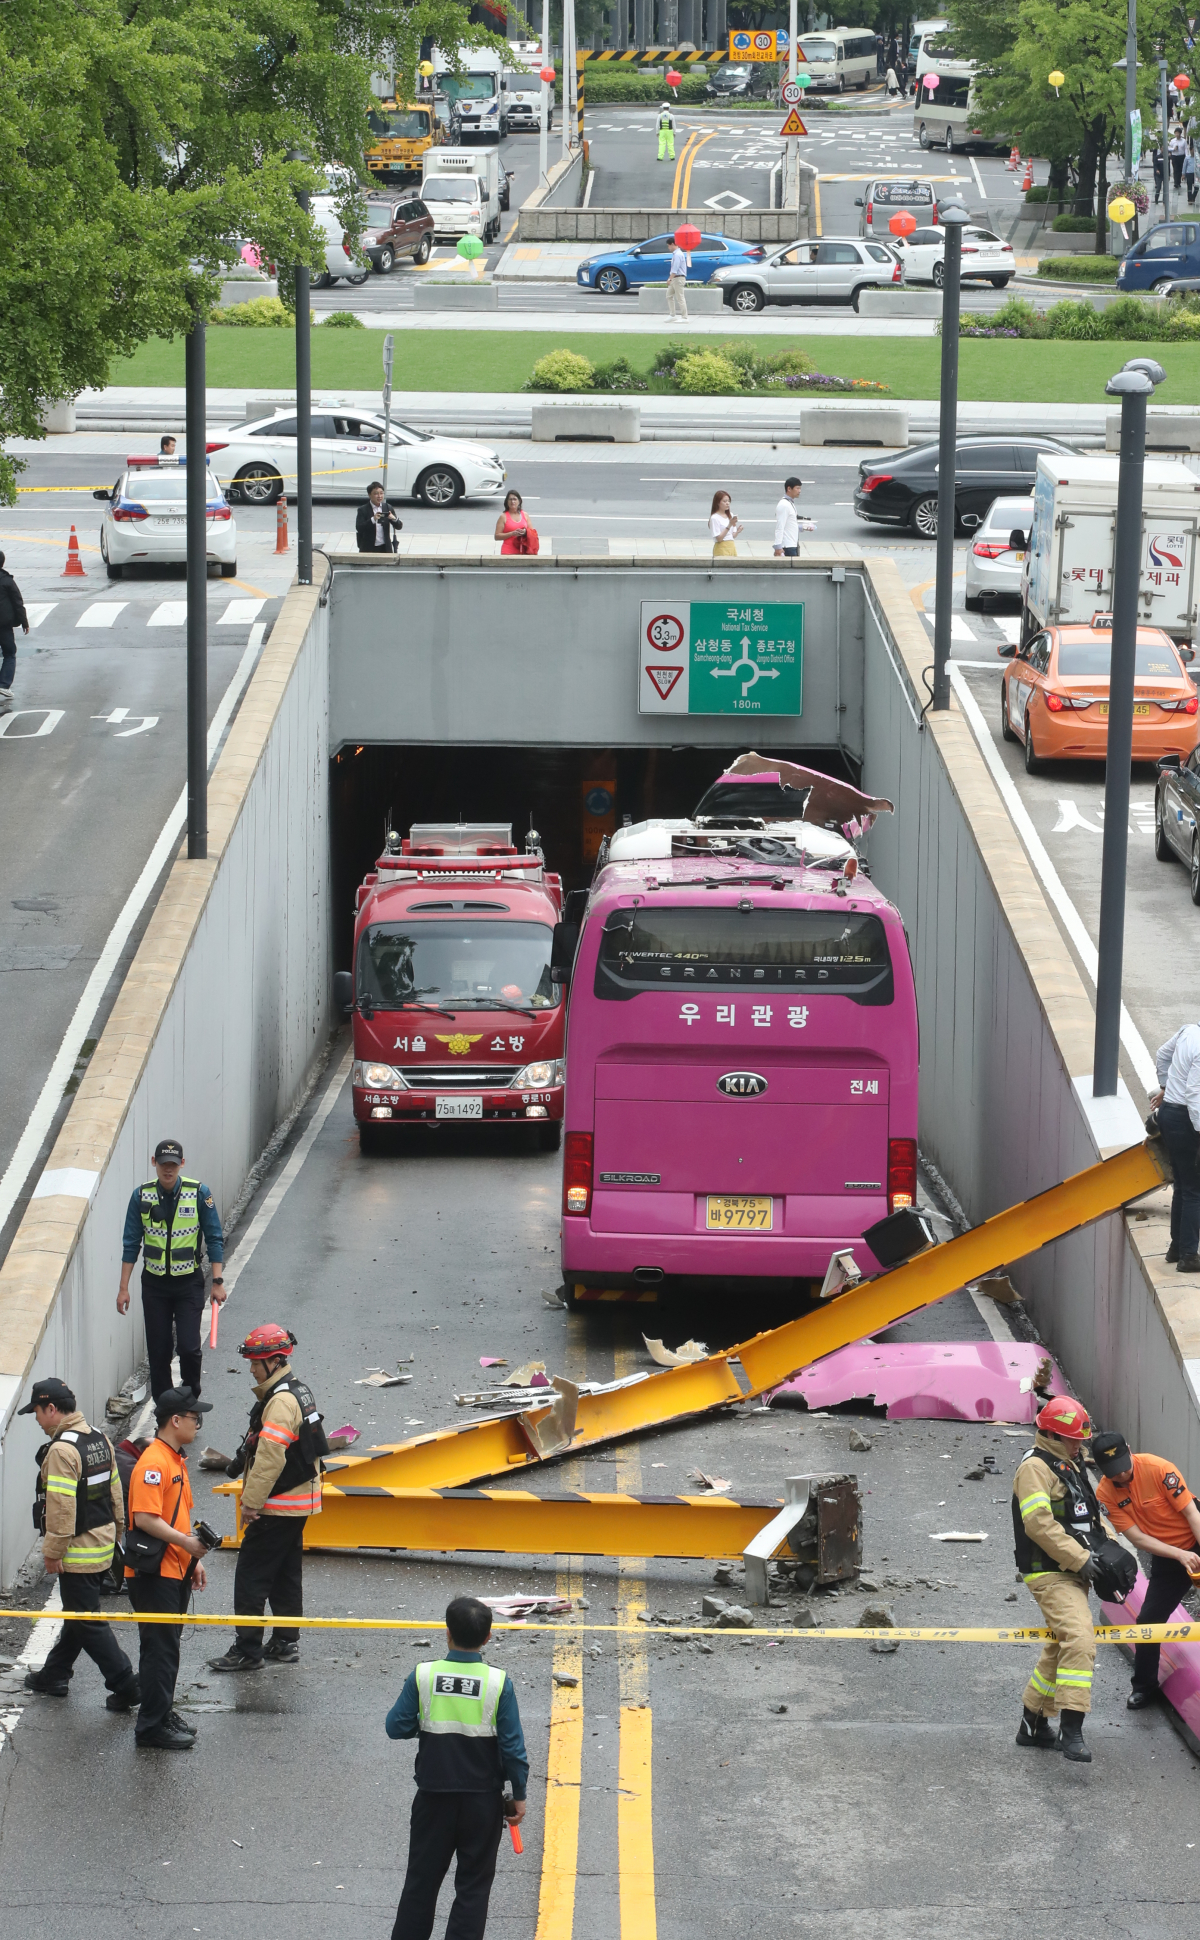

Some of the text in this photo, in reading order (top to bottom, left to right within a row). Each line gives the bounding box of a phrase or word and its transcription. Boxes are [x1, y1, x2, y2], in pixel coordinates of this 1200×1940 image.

[757, 36, 769, 47] 30
[786, 87, 800, 98] 30
[1167, 535, 1184, 545] 롯데
[1071, 567, 1104, 583] 롯데
[1146, 571, 1181, 587] 제과
[726, 608, 764, 622] 국세청
[653, 625, 677, 641] 3.3m
[721, 622, 769, 632] National Tax Service
[694, 638, 733, 653] 삼청동
[756, 639, 796, 653] 종로구청
[693, 652, 733, 664] Samcheong-dong
[756, 653, 795, 664] Jongno District Office
[656, 670, 674, 679] 천천히
[732, 699, 761, 709] 180m
[659, 966, 830, 980] GRANBIRD
[678, 1002, 810, 1029] 우리관광
[393, 1034, 427, 1053] 서울
[490, 1035, 526, 1053] 소방
[725, 1077, 760, 1094] KIA
[849, 1079, 880, 1096] 전세
[363, 1094, 401, 1105] 서울소방
[602, 1173, 659, 1184] SILKROAD
[723, 1198, 756, 1208] 경북 75
[1094, 1627, 1153, 1641] 서울소방
[1163, 1625, 1192, 1639] 119
[441, 1677, 475, 1695] 경찰
